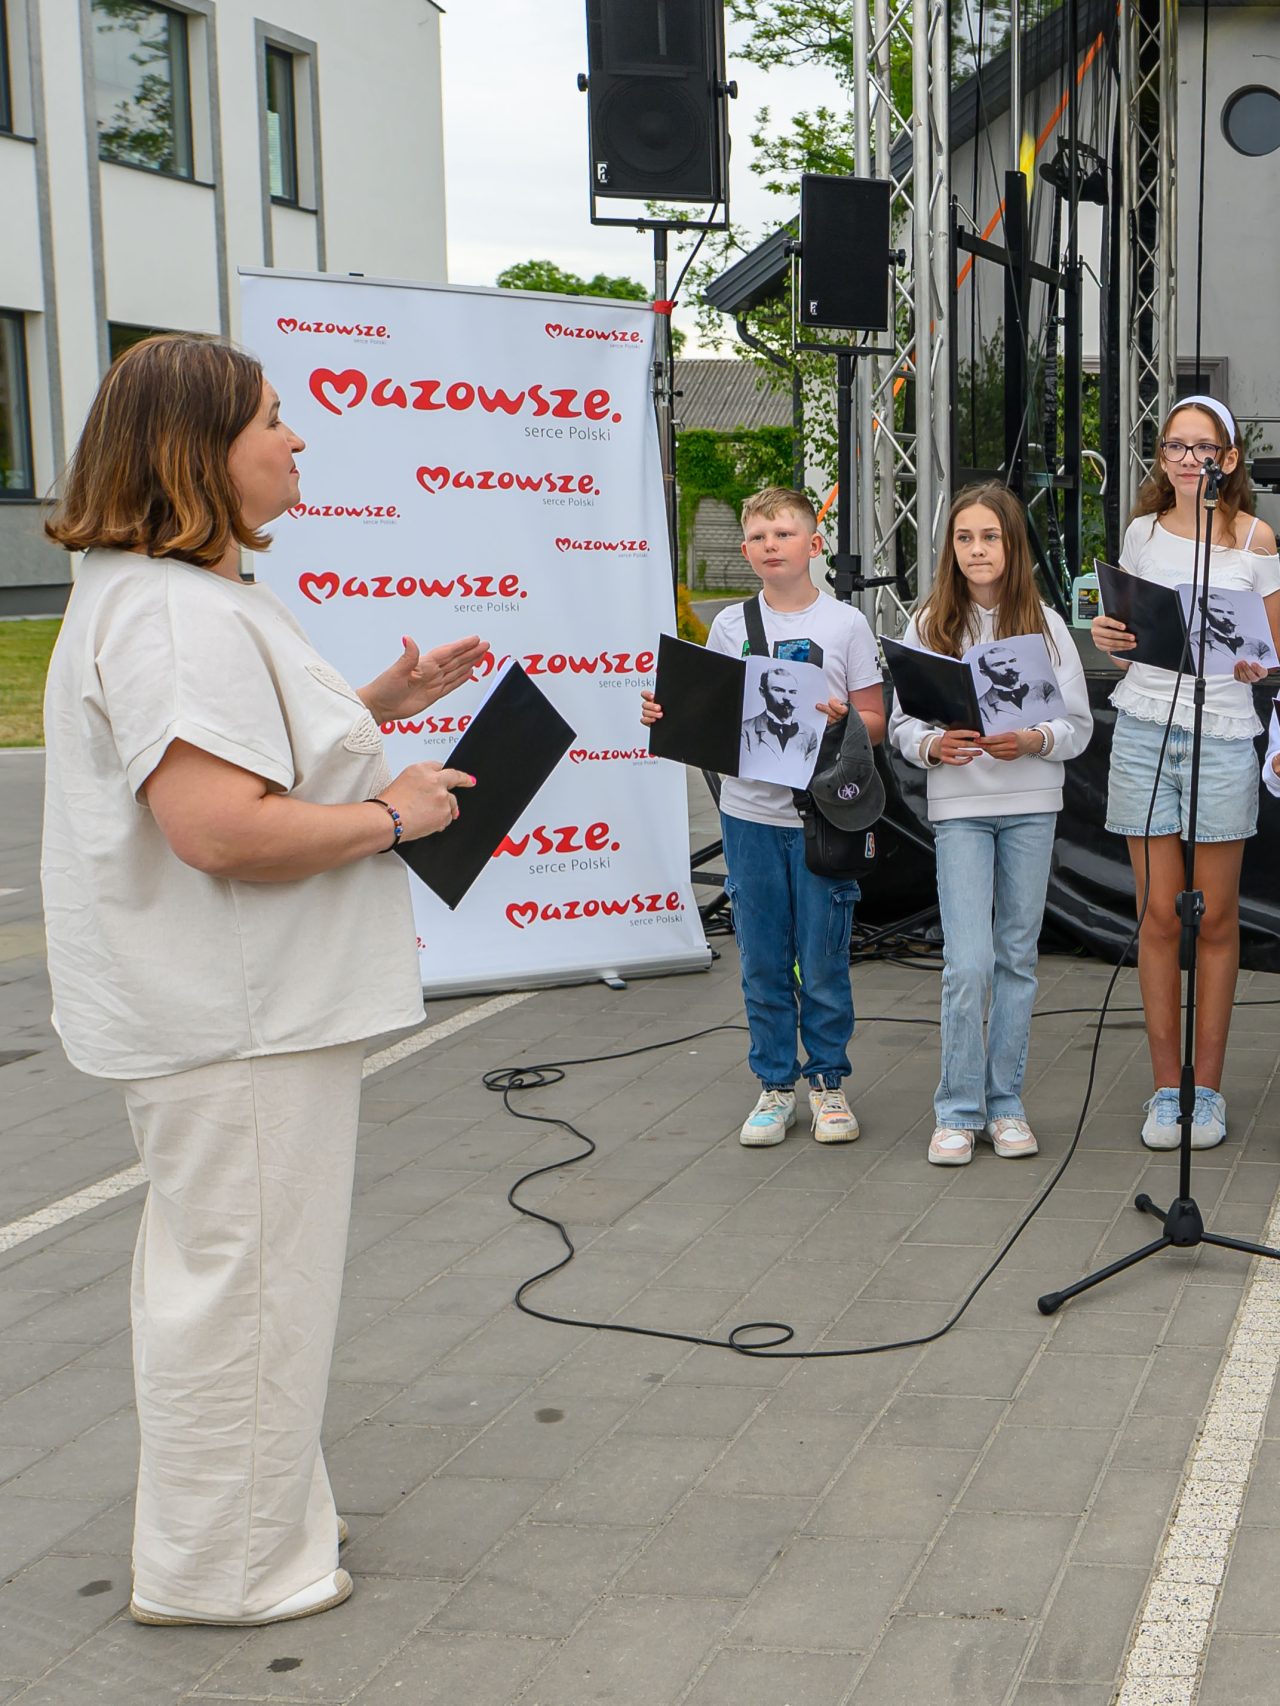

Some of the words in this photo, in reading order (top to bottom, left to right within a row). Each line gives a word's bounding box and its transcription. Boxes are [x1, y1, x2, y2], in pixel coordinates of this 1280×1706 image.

[525, 425, 563, 439] serce
[569, 426, 611, 441] Polski
[543, 498, 565, 506] serce
[568, 497, 594, 507] Polski
[454, 603, 483, 612] serce
[487, 602, 520, 612] Polski
[599, 679, 621, 688] serce
[625, 677, 654, 688] Polski
[529, 862, 566, 874] serce
[572, 856, 610, 871] Polski
[629, 916, 653, 926] serce
[656, 914, 683, 924] Polski
